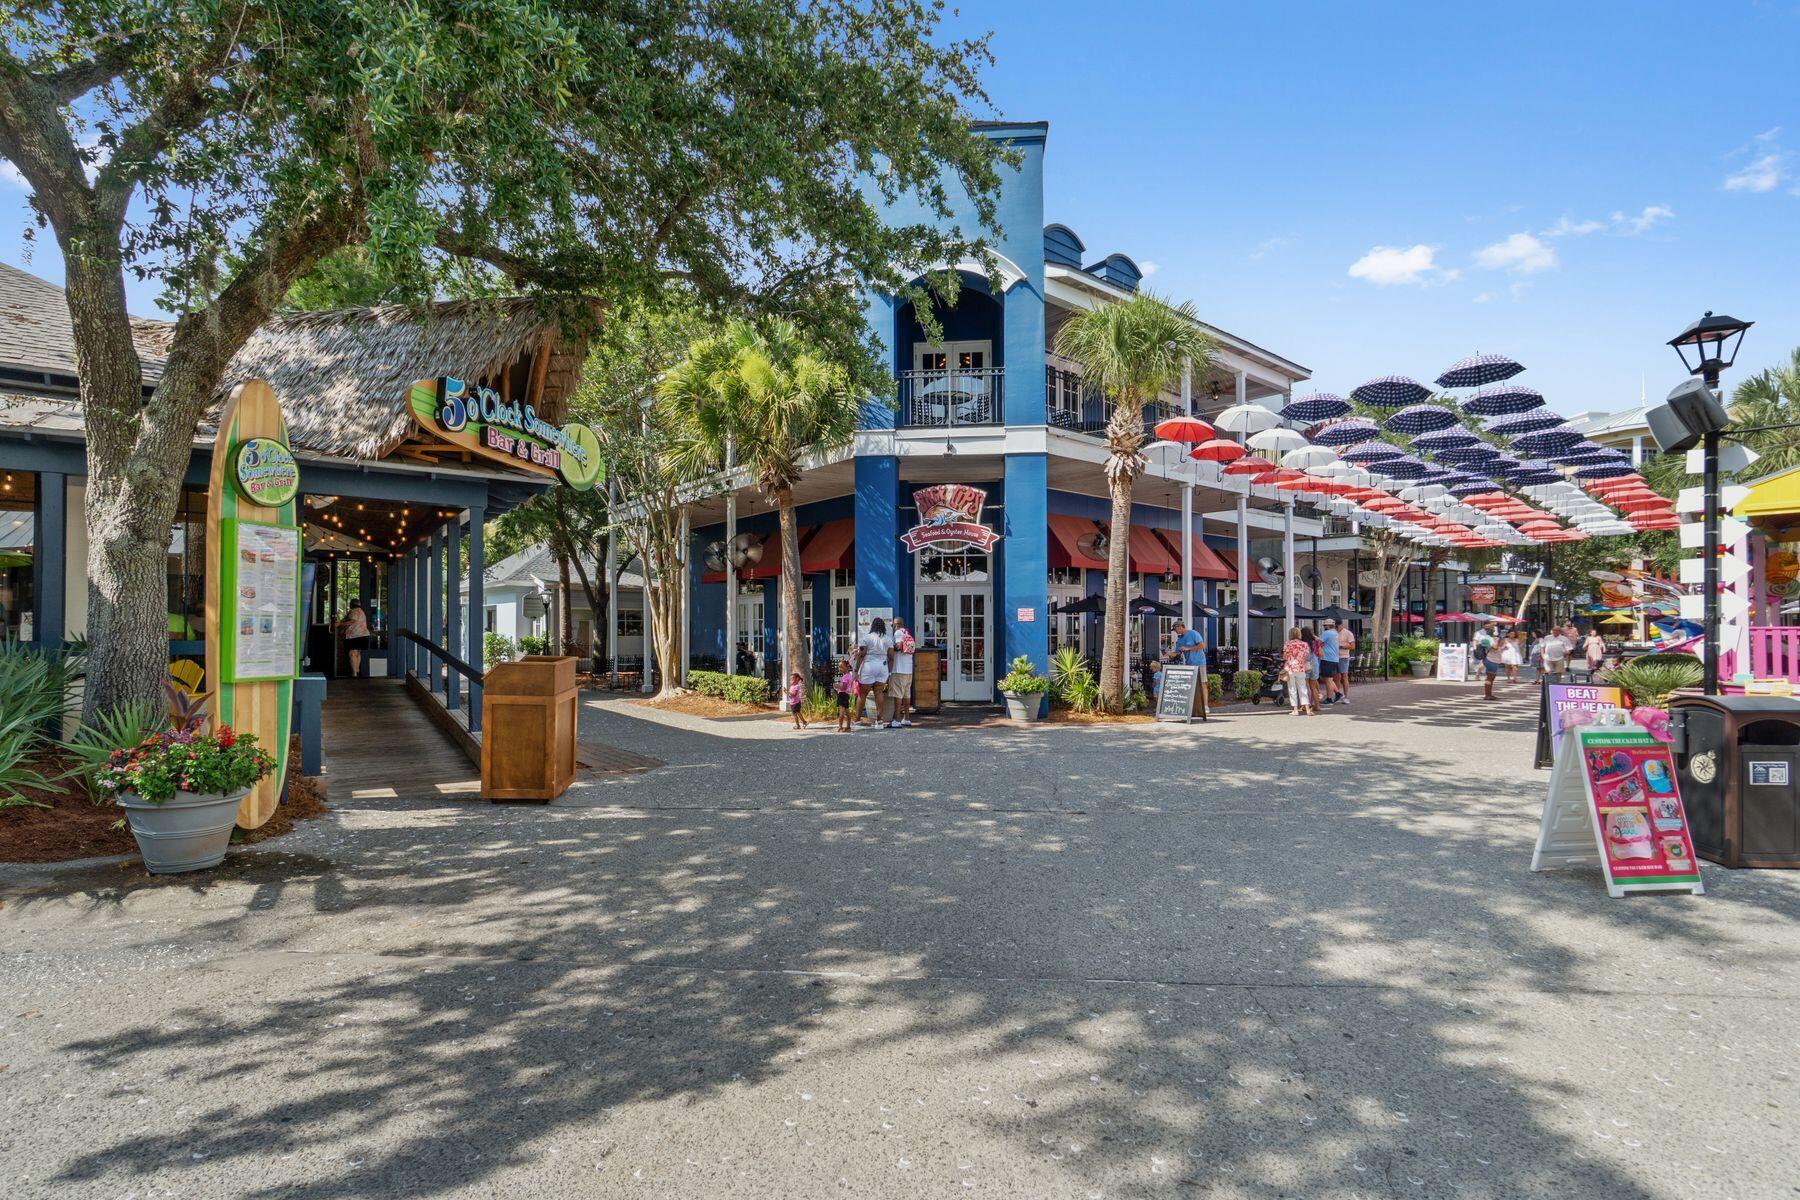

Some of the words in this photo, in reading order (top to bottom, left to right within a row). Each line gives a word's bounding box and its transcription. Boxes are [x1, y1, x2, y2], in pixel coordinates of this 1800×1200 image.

[442, 376, 467, 432] 5
[524, 404, 588, 463] Somewhere
[487, 425, 515, 455] Bar
[516, 439, 529, 461] &
[530, 441, 561, 469] Grill
[245, 440, 260, 468] 5
[250, 482, 266, 494] Bar
[921, 530, 941, 538] Seafood
[963, 530, 979, 538] House
[1567, 688, 1598, 700] BEAT
[1556, 701, 1578, 711] THE
[1580, 701, 1617, 713] HEAT!
